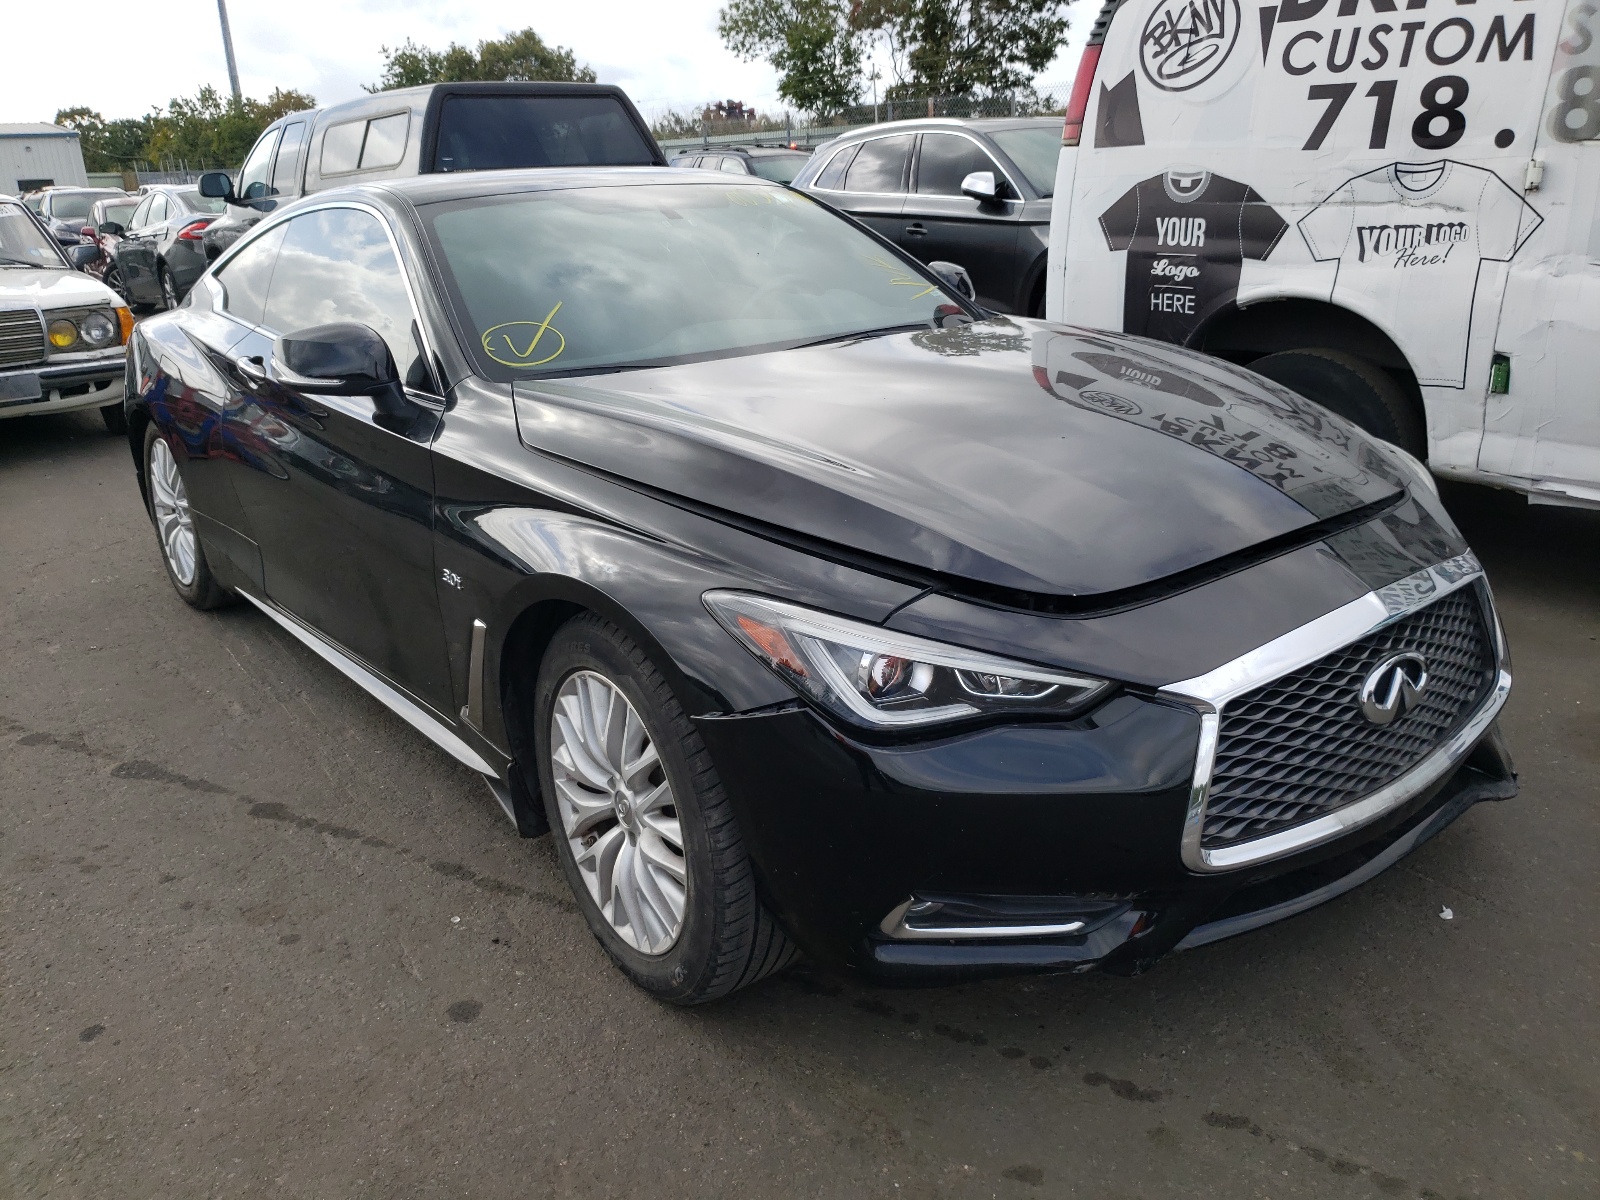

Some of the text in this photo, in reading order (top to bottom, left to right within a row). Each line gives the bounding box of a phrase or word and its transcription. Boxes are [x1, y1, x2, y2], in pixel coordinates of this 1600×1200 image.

[1282, 13, 1535, 75] CUSTOM
[1155, 217, 1206, 247] YOUR
[1357, 222, 1470, 263] YOUR LOGO
[1150, 259, 1201, 281] Logo
[1393, 243, 1455, 269] Here!
[1150, 292, 1196, 314] HERE
